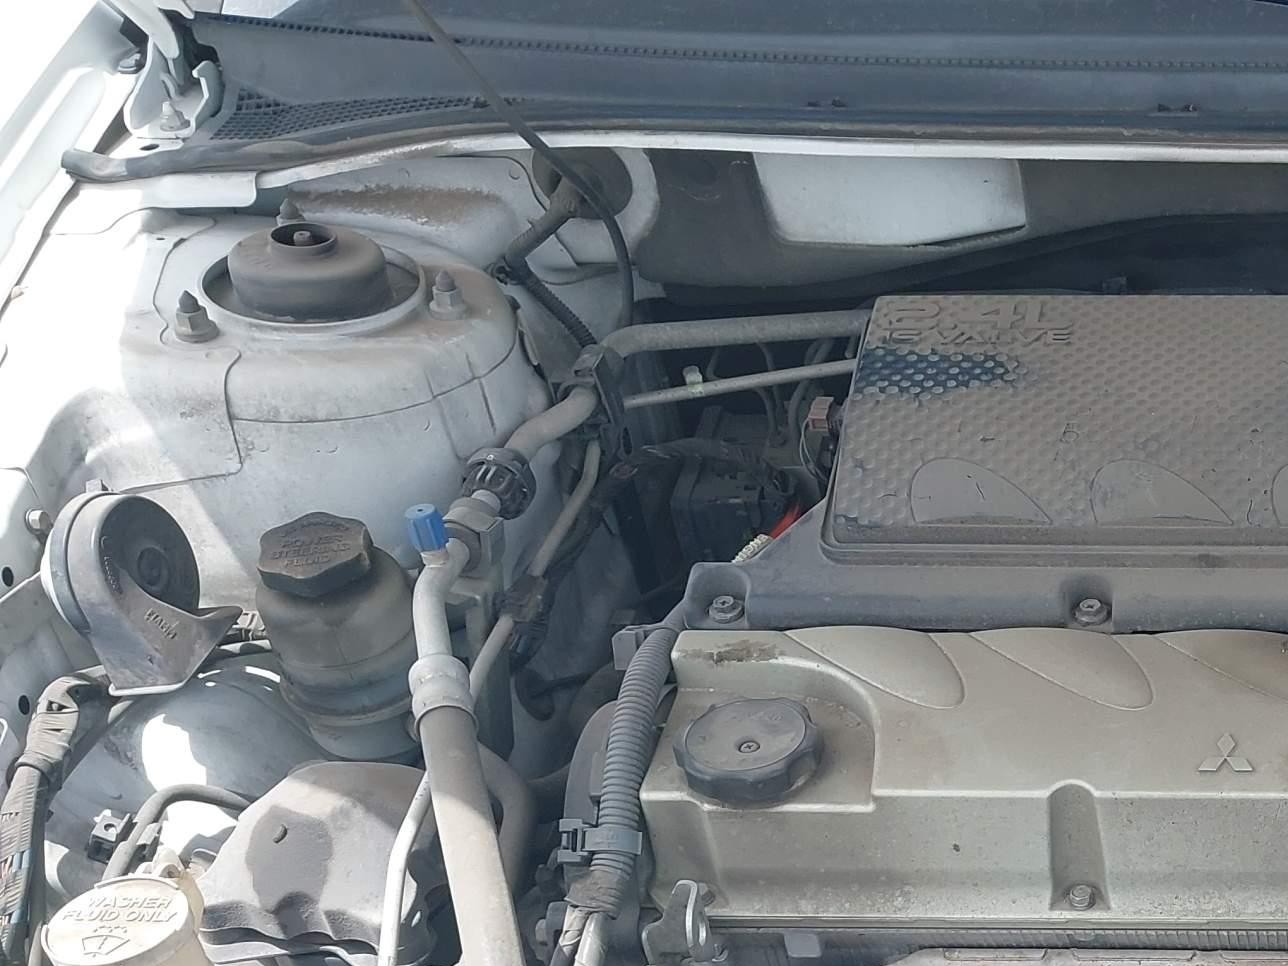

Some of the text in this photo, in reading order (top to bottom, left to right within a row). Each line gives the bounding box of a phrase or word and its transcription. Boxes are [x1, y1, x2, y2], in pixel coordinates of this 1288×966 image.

[884, 302, 1074, 330] 2.4L
[936, 329, 1075, 346] VALVE
[281, 534, 344, 549] POWER
[272, 542, 352, 560] STEERING
[283, 554, 332, 567] FLUID
[88, 896, 173, 909] WASHER
[62, 910, 178, 923] FLUID ONLY
